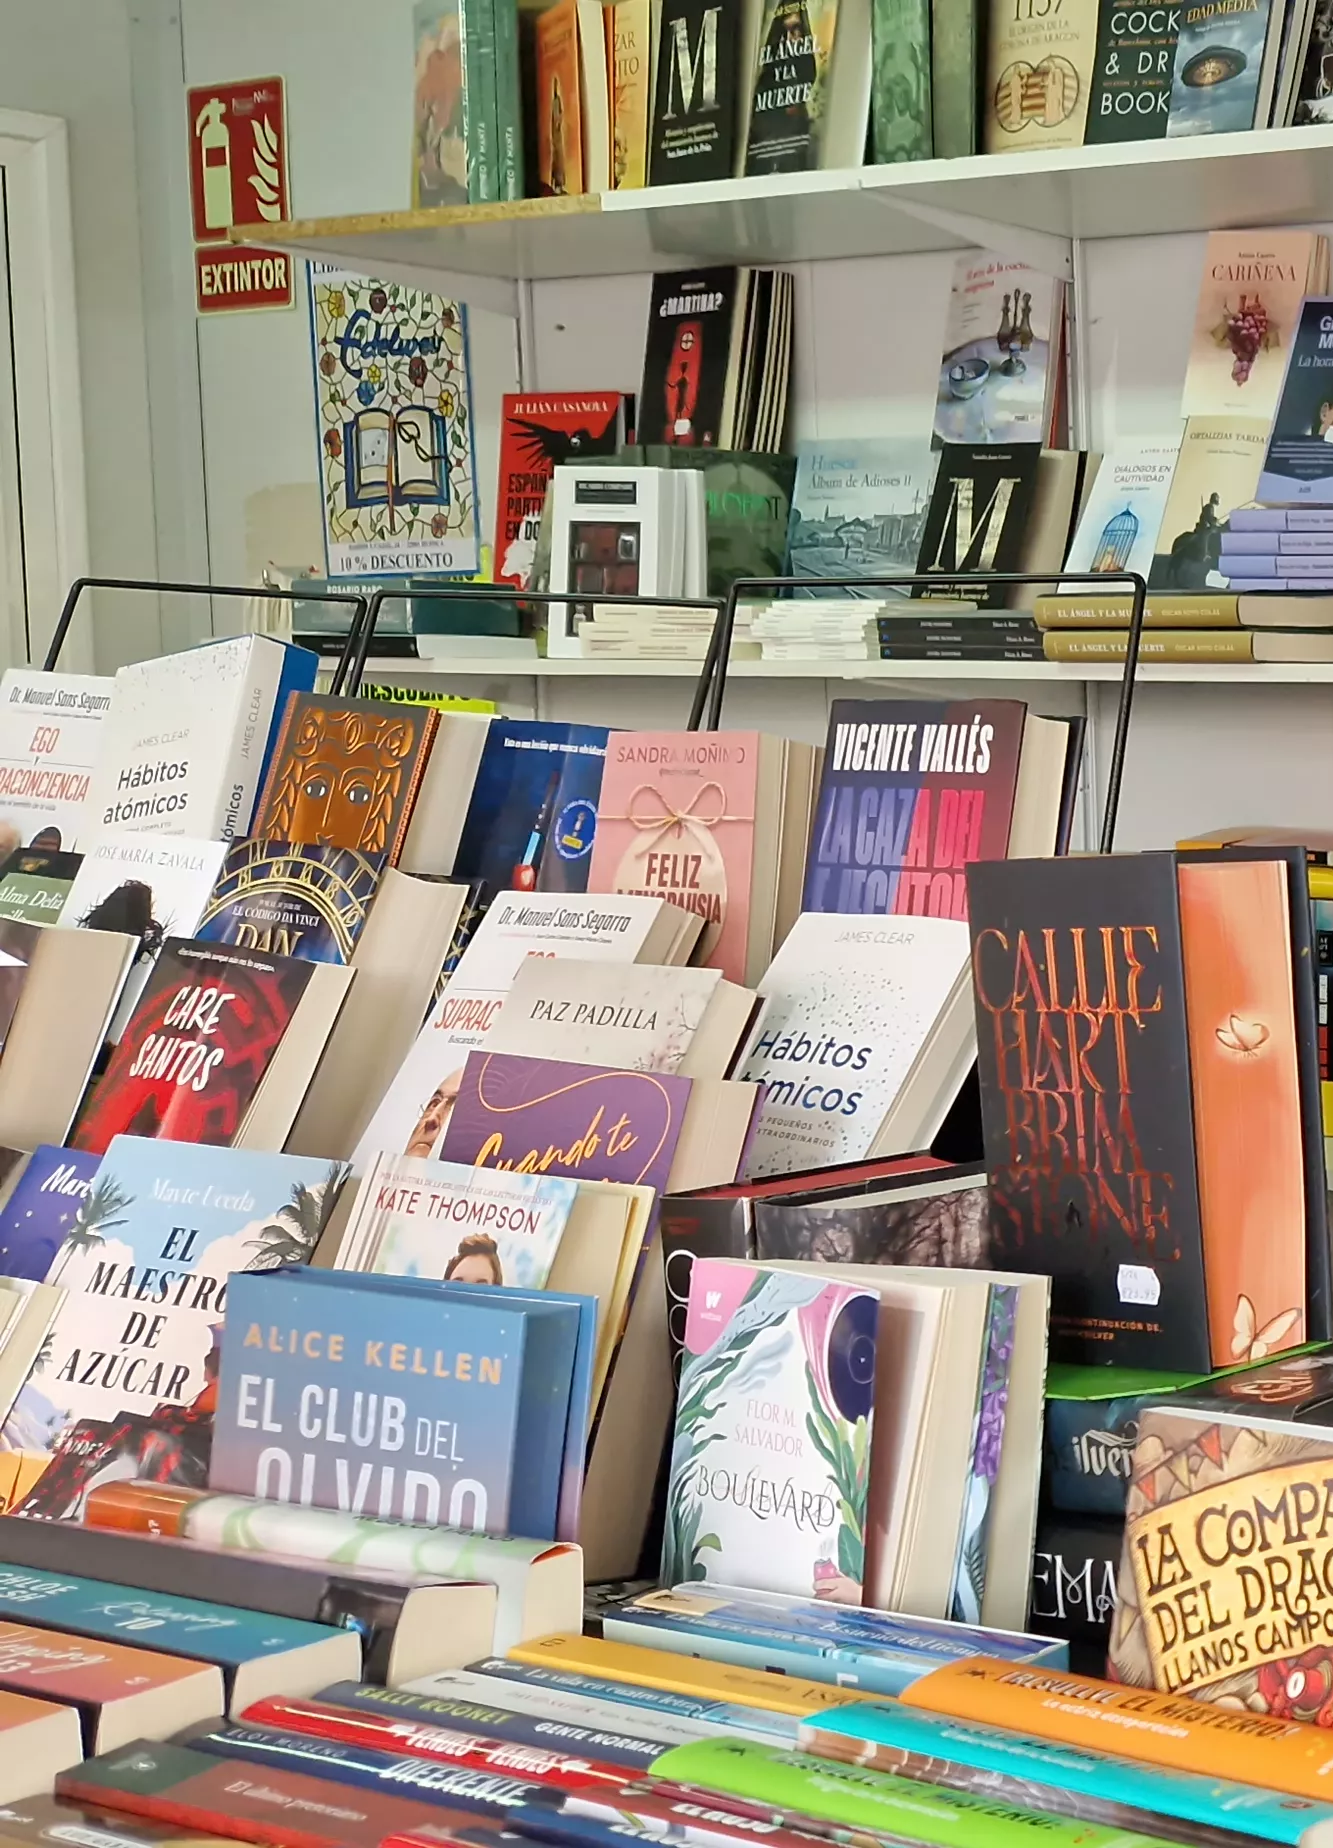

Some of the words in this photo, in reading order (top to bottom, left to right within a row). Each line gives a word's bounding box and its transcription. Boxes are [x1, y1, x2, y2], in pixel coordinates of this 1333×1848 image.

[663, 6, 722, 120] M
[1105, 53, 1121, 75] &
[756, 83, 812, 116] MUERTE
[201, 257, 288, 296] EXTINTOR
[1212, 262, 1297, 282] CARIÑENA
[553, 402, 609, 413] CASANOVA
[861, 472, 900, 488] Adioses
[927, 477, 1021, 574] M
[340, 557, 353, 572] 10
[354, 556, 368, 571] %
[370, 551, 454, 571] DESCUENTO
[22, 687, 57, 705] Manuel
[248, 687, 263, 724] CLEAR
[29, 725, 60, 754] EGO
[832, 724, 917, 772] VICENTE
[919, 714, 995, 774] VALLÉS
[117, 760, 189, 791] Hábitos
[103, 791, 189, 825] atómicos
[818, 787, 854, 864] LA
[855, 788, 930, 867] CAZA
[935, 789, 986, 868] DEL
[645, 853, 702, 889] FELIZ
[497, 906, 514, 925] Dr.
[516, 907, 555, 928] Manuel
[556, 911, 581, 929] Sans
[582, 911, 632, 935] Segarra
[834, 931, 872, 944] JAMES
[874, 932, 915, 946] CLEAR
[234, 924, 305, 957] DAN
[975, 926, 1163, 1013] CALLIE
[163, 986, 236, 1035] CARE
[530, 999, 566, 1022] PAZ
[573, 1003, 660, 1031] PADILLA
[129, 1033, 225, 1092] SANTOS
[751, 1028, 873, 1071] Hábitos
[995, 1008, 1147, 1094] HART
[476, 1105, 603, 1174] Cuando
[609, 1112, 638, 1158] te
[1003, 1089, 1147, 1175] BRIM
[148, 1175, 198, 1208] Mayte
[375, 1186, 418, 1215] KATE
[427, 1195, 542, 1235] THOMPSON
[160, 1226, 199, 1264] EL
[119, 1311, 168, 1349] DE
[244, 1322, 345, 1363] ALICE
[364, 1340, 503, 1387] KELLEN
[56, 1347, 190, 1402] AZÚCAR
[236, 1374, 283, 1433] EL
[299, 1384, 407, 1452] CLUB
[415, 1417, 465, 1464] DEL
[746, 1398, 780, 1424] FLOR
[734, 1426, 804, 1459] SALVADOR
[695, 1464, 836, 1534] BOULEVARD
[1137, 1523, 1191, 1596] LA
[1152, 1582, 1232, 1653] DEL
[1162, 1640, 1249, 1694] LLANOS
[420, 1699, 517, 1726] ROONEY
[534, 1721, 593, 1741] GENTE
[594, 1728, 665, 1756] NORMAL
